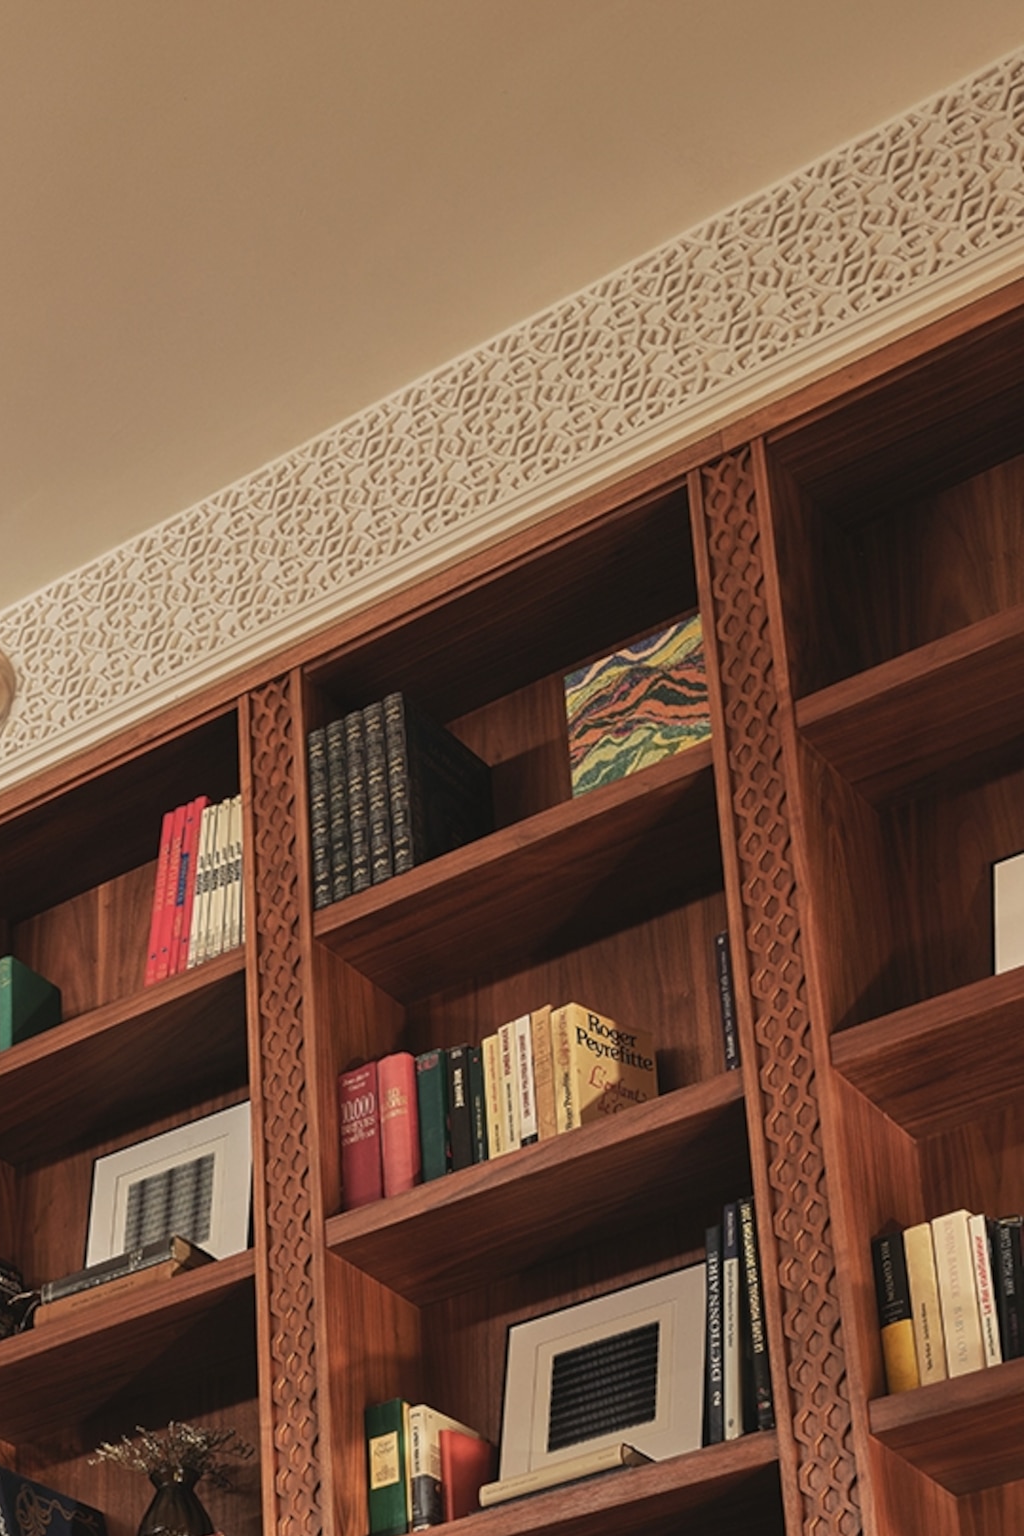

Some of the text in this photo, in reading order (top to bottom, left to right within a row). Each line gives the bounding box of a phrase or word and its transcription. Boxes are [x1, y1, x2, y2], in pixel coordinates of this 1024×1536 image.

[575, 1026, 654, 1071] Peyrefitte
[587, 1012, 637, 1047] Roger
[882, 1263, 897, 1303] CLINTON
[708, 1252, 722, 1382] DICTIONNAIRE
